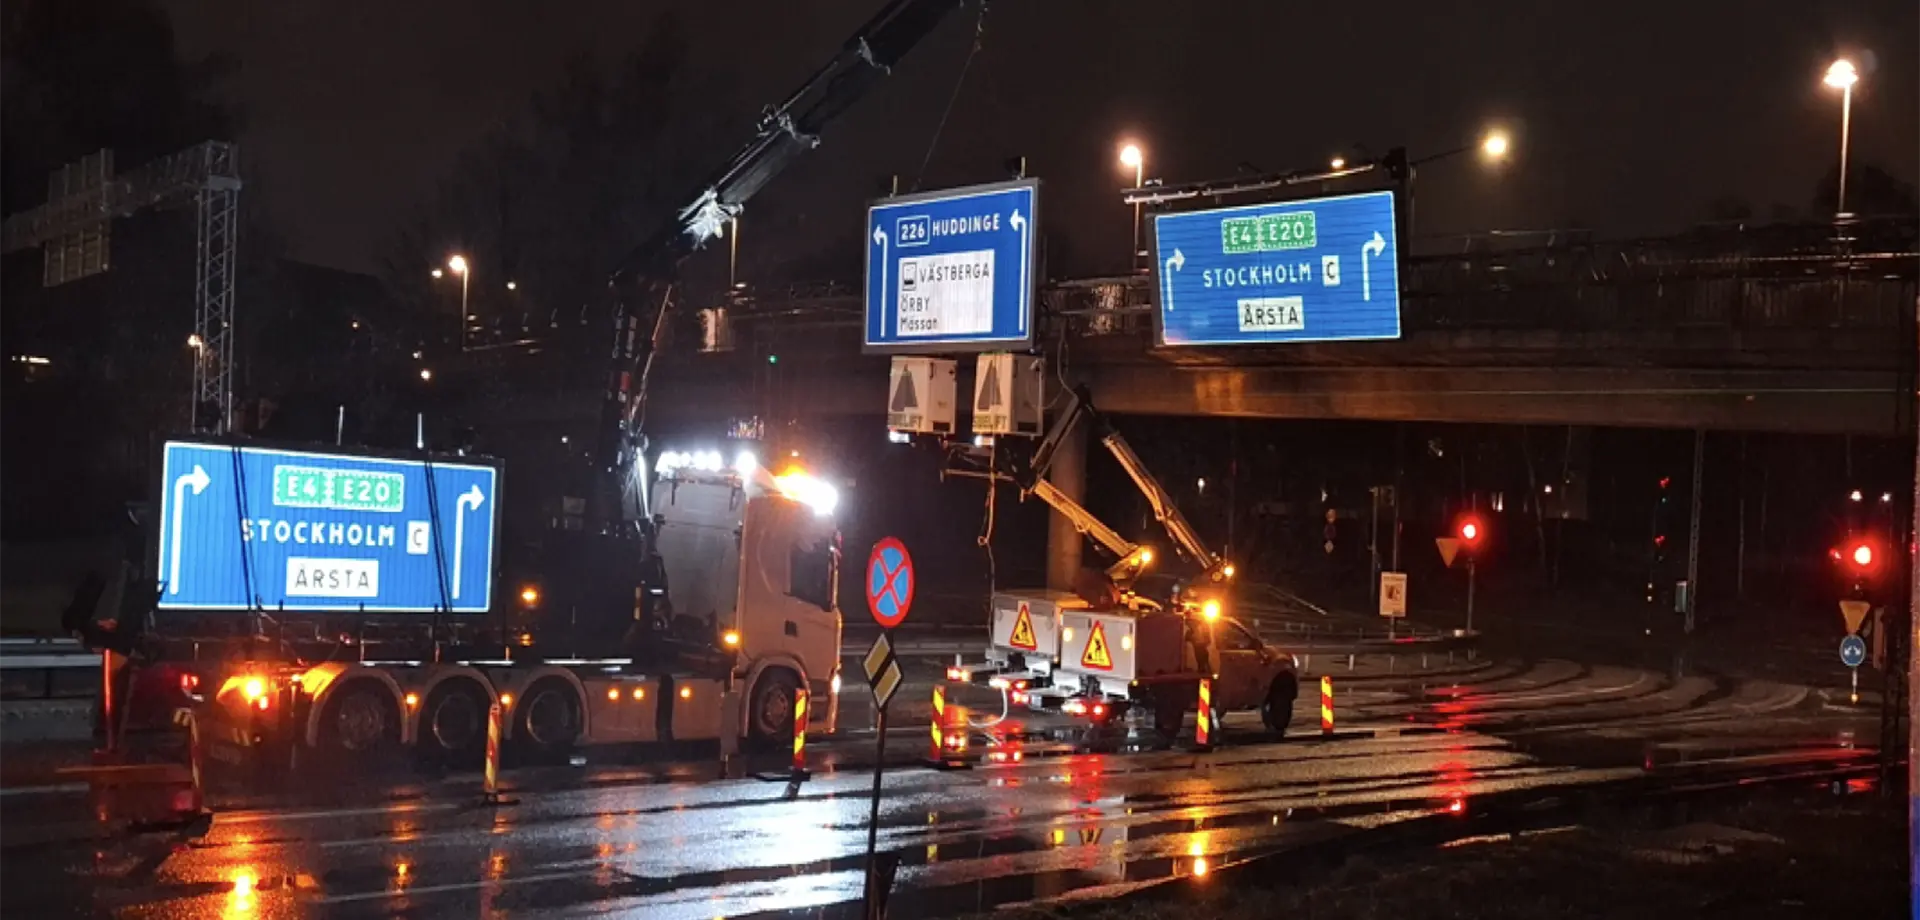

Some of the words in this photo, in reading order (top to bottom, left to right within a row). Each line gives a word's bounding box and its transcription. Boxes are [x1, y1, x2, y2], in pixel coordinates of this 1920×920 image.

[901, 223, 925, 241] 226
[932, 213, 1000, 236] HUDDINGE
[1230, 225, 1251, 245] E4
[1269, 221, 1305, 241] E20
[919, 262, 990, 283] VÄSTBERGA
[1203, 262, 1312, 288] STOCKHOLM
[1326, 262, 1336, 279] C
[900, 295, 930, 312] ÖRBY
[1244, 301, 1298, 325] ÅRSTA
[287, 477, 317, 498] E4
[343, 479, 390, 501] E20
[241, 518, 395, 547] STOCKHOLM
[412, 527, 424, 547] C
[295, 565, 370, 589] ÅRSTA
